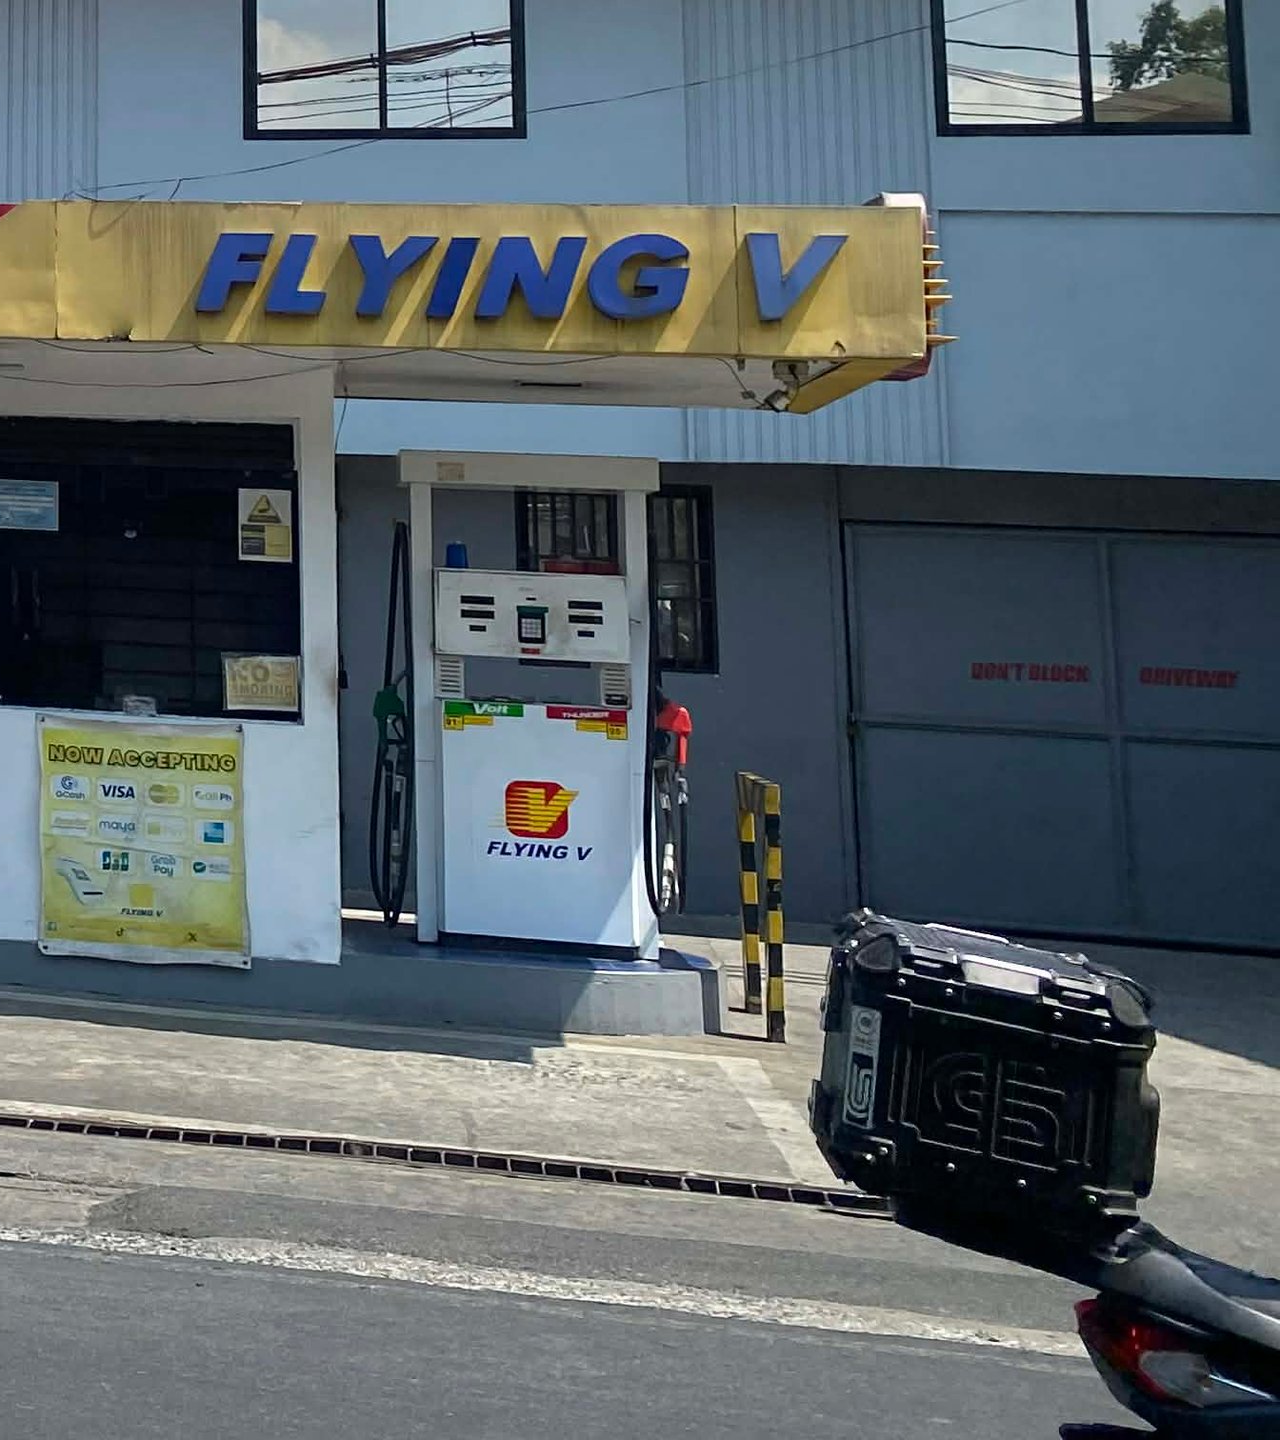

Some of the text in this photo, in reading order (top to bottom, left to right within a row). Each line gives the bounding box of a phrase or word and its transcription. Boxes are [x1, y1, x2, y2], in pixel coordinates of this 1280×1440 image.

[194, 232, 848, 321] FLYING V
[971, 662, 1238, 689] DON'T BLOCK DRIVEWAY
[473, 703, 509, 715] Volt
[48, 744, 236, 772] NOW ACCEPTING
[100, 784, 135, 799] VISA
[99, 821, 136, 832] maya
[487, 841, 593, 861] FLYING V
[154, 865, 173, 877] Pay
[120, 908, 154, 917] FLYING
